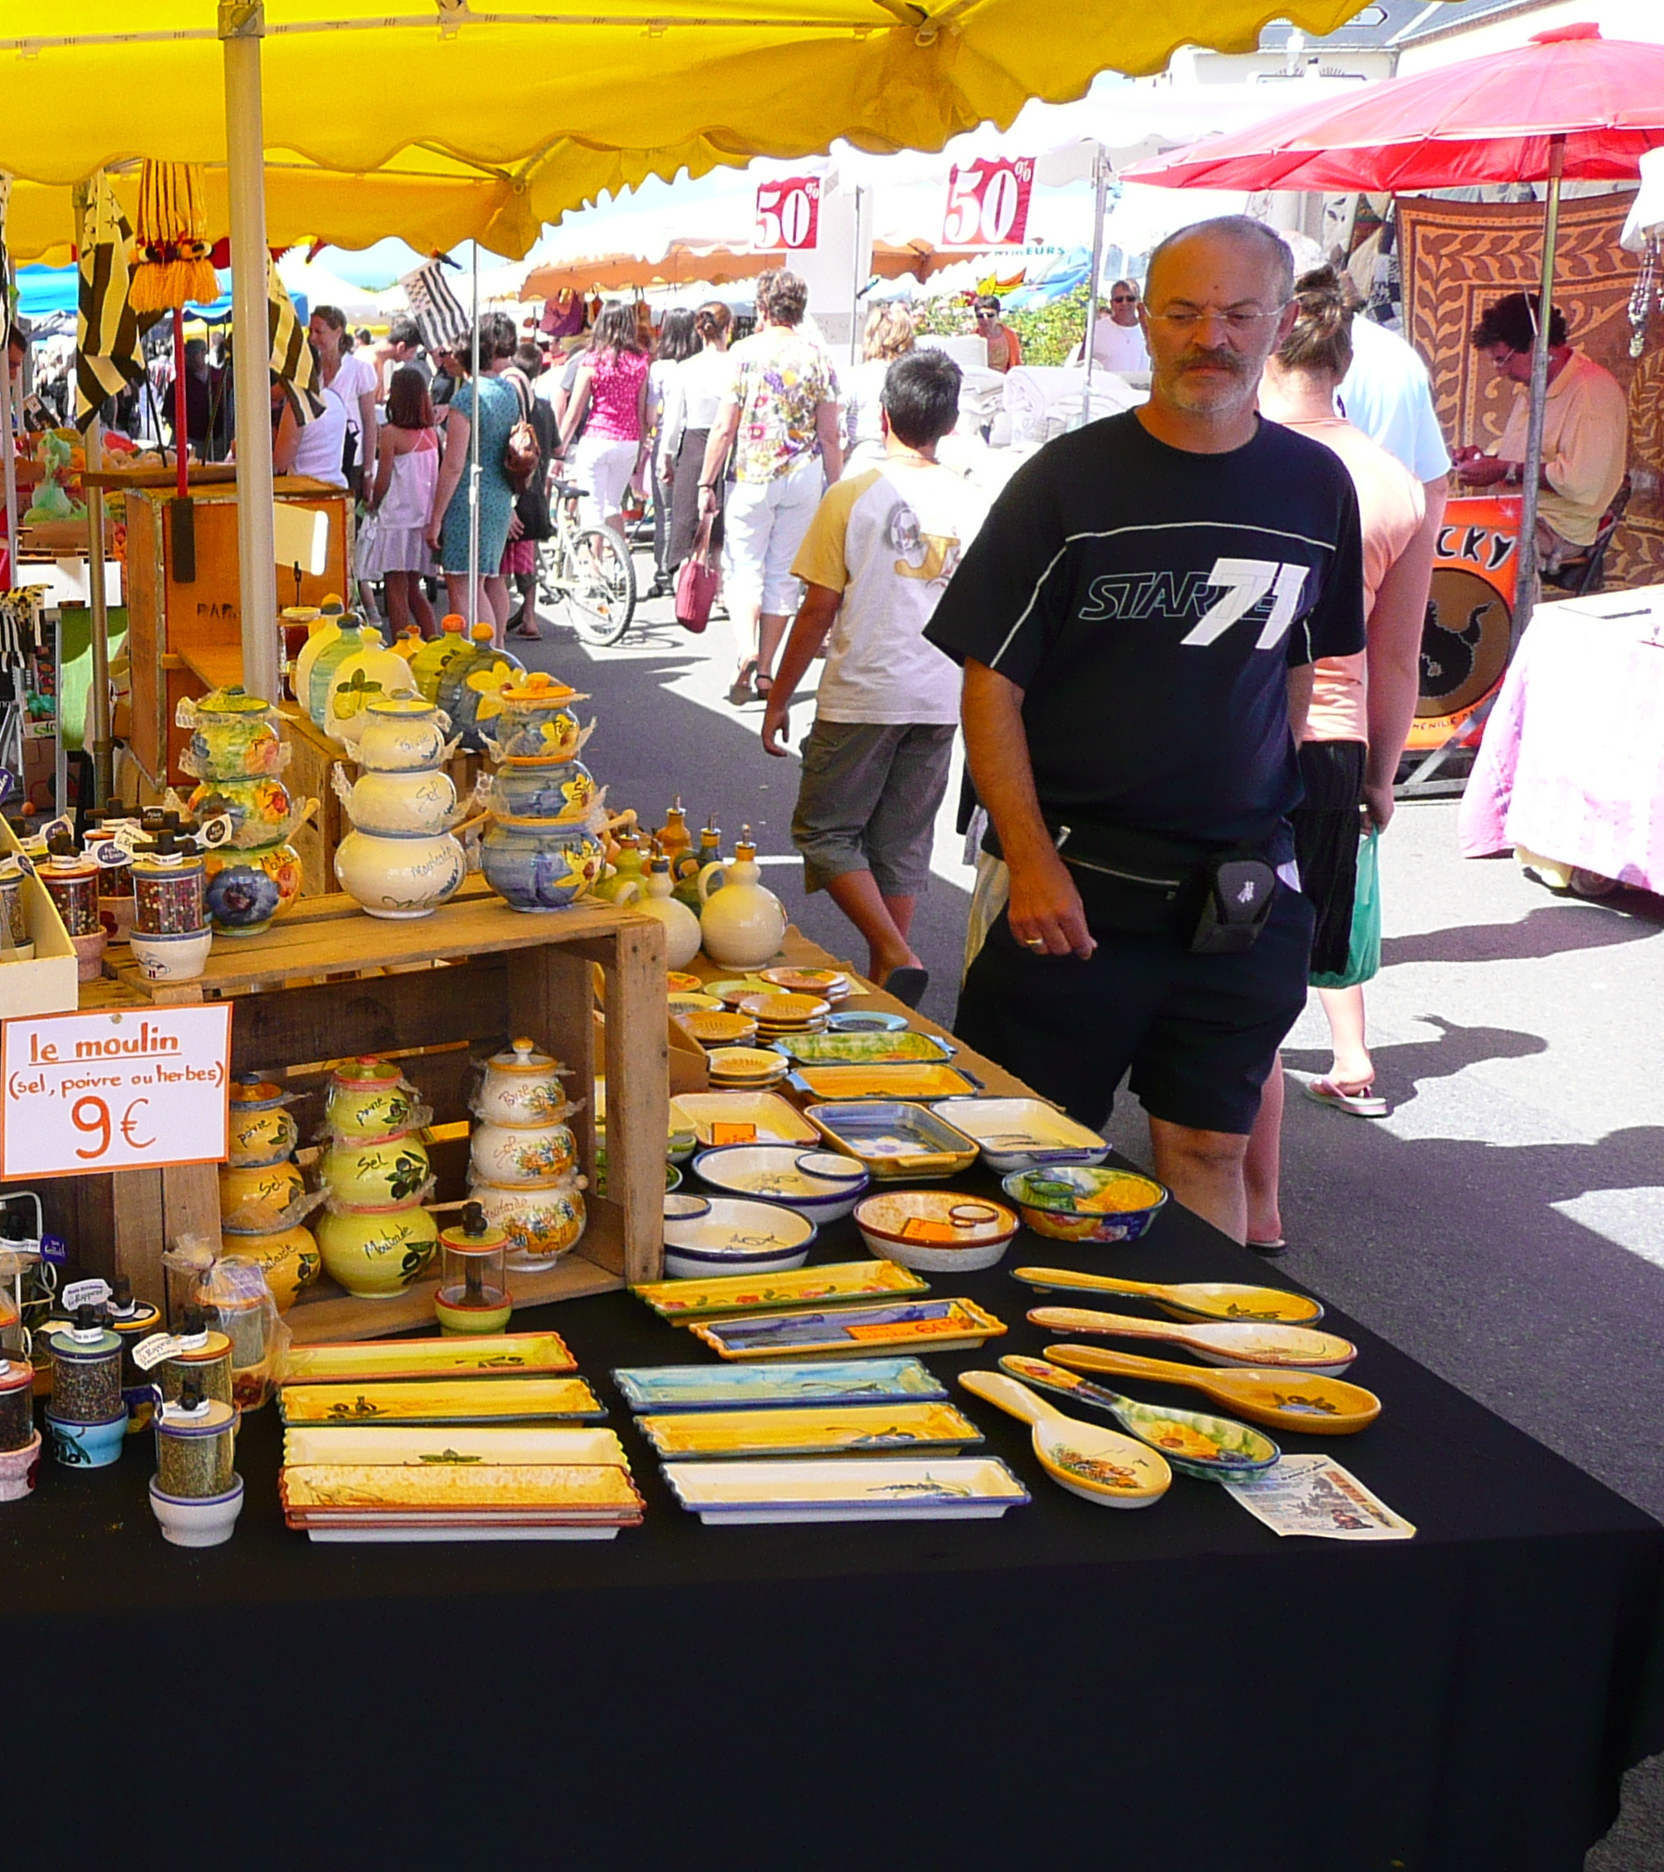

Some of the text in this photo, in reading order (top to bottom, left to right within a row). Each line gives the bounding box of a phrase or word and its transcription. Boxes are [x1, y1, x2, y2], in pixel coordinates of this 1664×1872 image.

[1180, 557, 1311, 650] 71
[30, 1021, 178, 1062] le moulin
[61, 1072, 122, 1098] poivre
[131, 1074, 152, 1085] ou
[156, 1061, 224, 1089] herbes)
[356, 1097, 388, 1127] poivre
[237, 1118, 272, 1149] poivre
[356, 1152, 389, 1180] Sel
[259, 1174, 285, 1200] Sel
[364, 1223, 414, 1261] Moutarde
[254, 1243, 299, 1274] outarde
